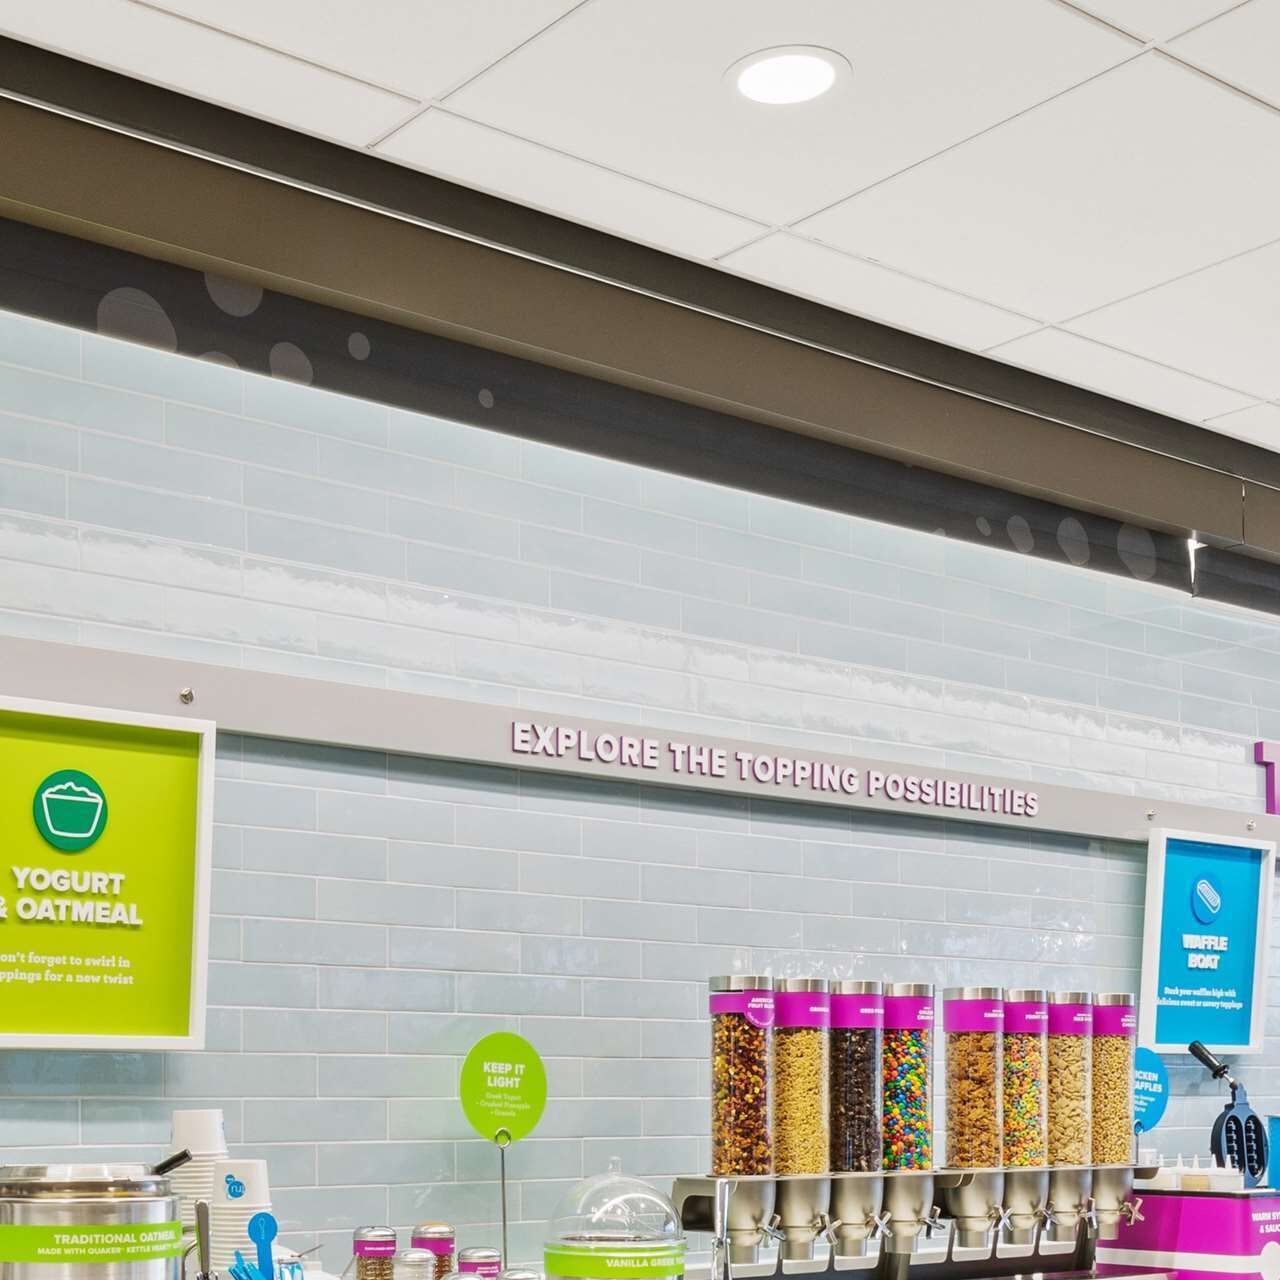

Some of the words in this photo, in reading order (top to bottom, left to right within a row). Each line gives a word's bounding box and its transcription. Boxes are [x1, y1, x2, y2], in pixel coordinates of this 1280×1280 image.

[512, 721, 659, 768] EXPLORE
[668, 741, 727, 778] THE
[734, 750, 860, 797] TOPPING
[867, 770, 1040, 818] POSSIBILITIES
[11, 866, 125, 895] YOGURT
[15, 897, 143, 926] OATMEAL
[1181, 934, 1229, 951] WAFFLE
[28, 952, 67, 967] forget
[70, 955, 82, 966] to
[85, 955, 116, 967] swirl
[118, 957, 131, 968] in
[1187, 953, 1220, 969] BOAT
[44, 970, 64, 982] for
[66, 975, 74, 983] a
[76, 974, 100, 984] new
[103, 973, 135, 985] twist
[483, 1061, 513, 1074] KEEP
[514, 1064, 526, 1075] IT
[487, 1075, 521, 1088] LIGHT
[1135, 1070, 1159, 1082] ICKEN
[1135, 1081, 1163, 1093] AFFLES
[1251, 1211, 1271, 1222] WARM
[1259, 1225, 1265, 1233] &
[54, 1233, 137, 1245] TRADITIONAL
[37, 1247, 62, 1255] MADE
[64, 1247, 86, 1255] WITH
[606, 1257, 649, 1268] VANILLA
